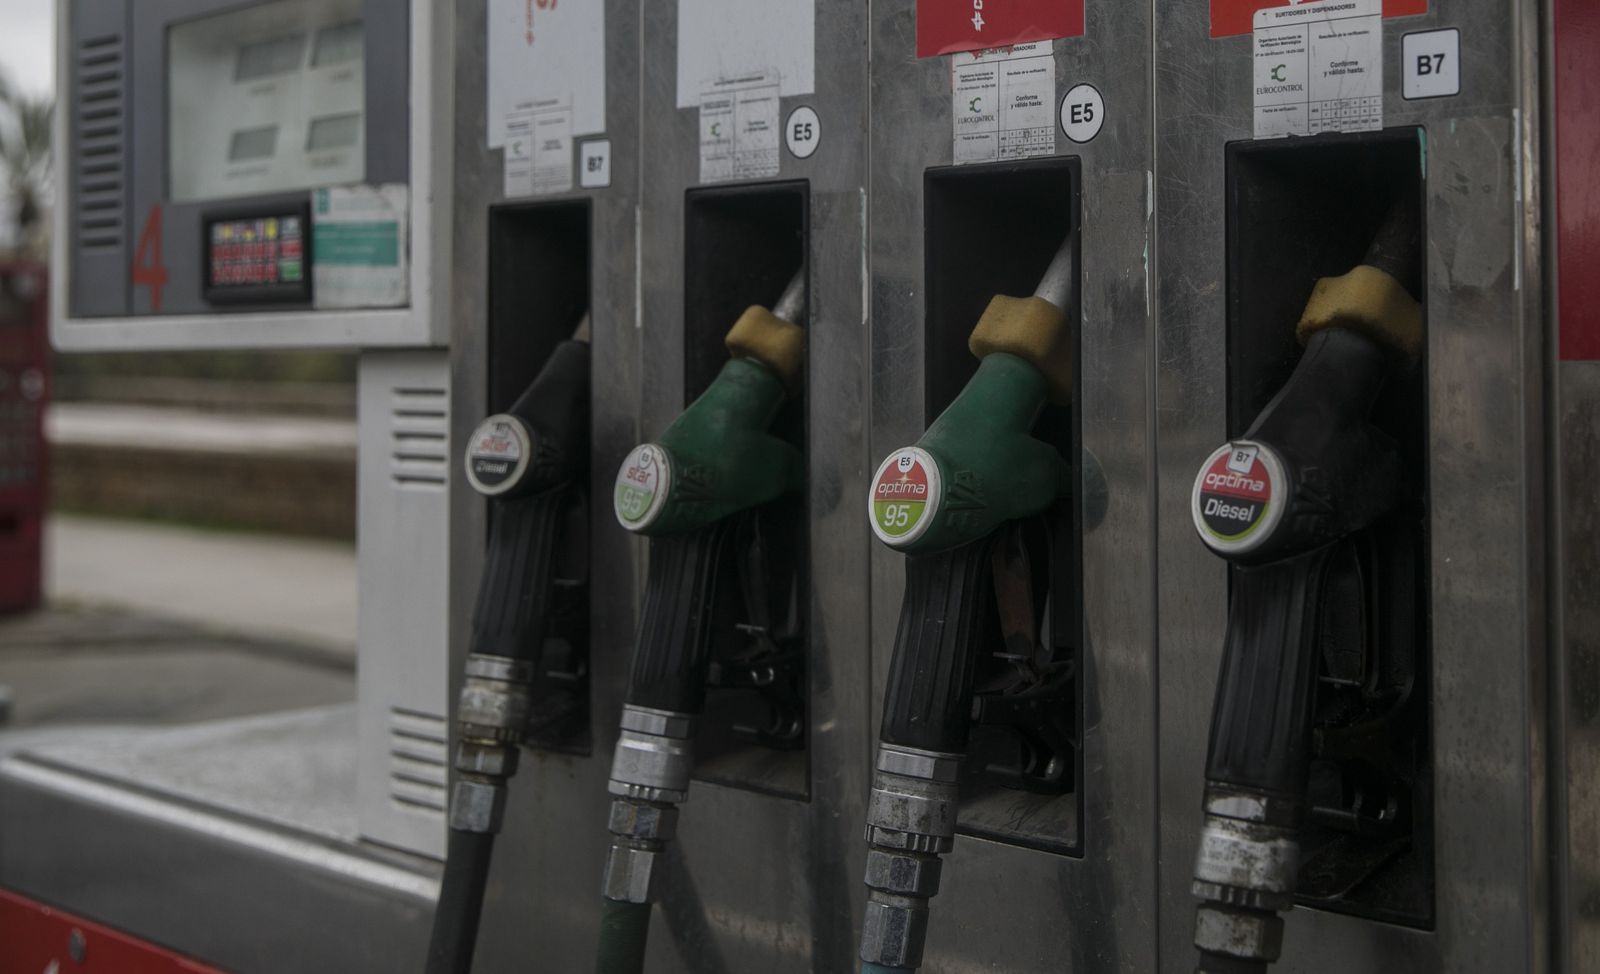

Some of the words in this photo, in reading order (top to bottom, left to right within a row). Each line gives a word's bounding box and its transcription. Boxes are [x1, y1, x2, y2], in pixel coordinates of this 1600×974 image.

[1275, 9, 1307, 18] SURTIDORES
[1312, 3, 1356, 13] DISPENSADORES
[1330, 60, 1358, 68] Conforme
[1416, 53, 1445, 76] B7
[1015, 94, 1038, 102] Conforme
[1256, 84, 1304, 95] EUROCONTROL
[958, 114, 995, 125] EUROCONTROL
[1070, 102, 1094, 124] E5
[793, 123, 812, 142] E5
[587, 155, 603, 172] B7
[130, 203, 169, 311] 4
[900, 457, 911, 466] E5
[1235, 451, 1250, 464] B7
[626, 465, 651, 484] star
[1206, 472, 1265, 492] optima
[878, 481, 925, 497] optima
[622, 488, 643, 513] 95
[884, 504, 911, 527] 95
[1204, 498, 1255, 522] Diesel
